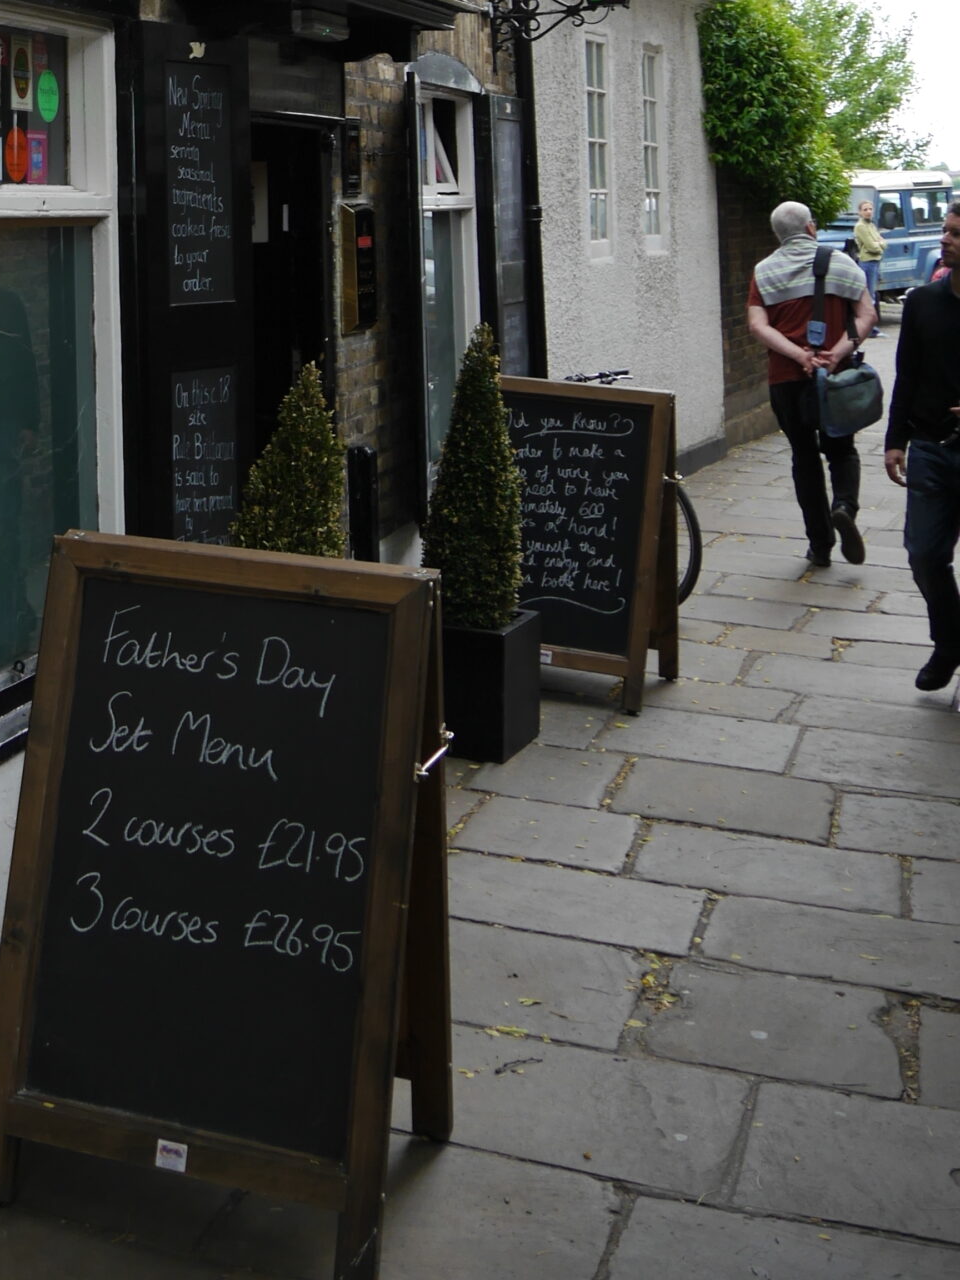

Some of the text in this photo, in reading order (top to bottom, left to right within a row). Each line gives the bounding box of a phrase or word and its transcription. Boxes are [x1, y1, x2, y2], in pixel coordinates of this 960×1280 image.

[168, 75, 188, 106] New
[578, 501, 605, 516] 600
[103, 604, 336, 718] Father's Day
[89, 690, 279, 781] Set Menu
[82, 787, 367, 883] 2 courses £21.95
[70, 871, 104, 934] 3
[243, 909, 362, 972] £26.95
